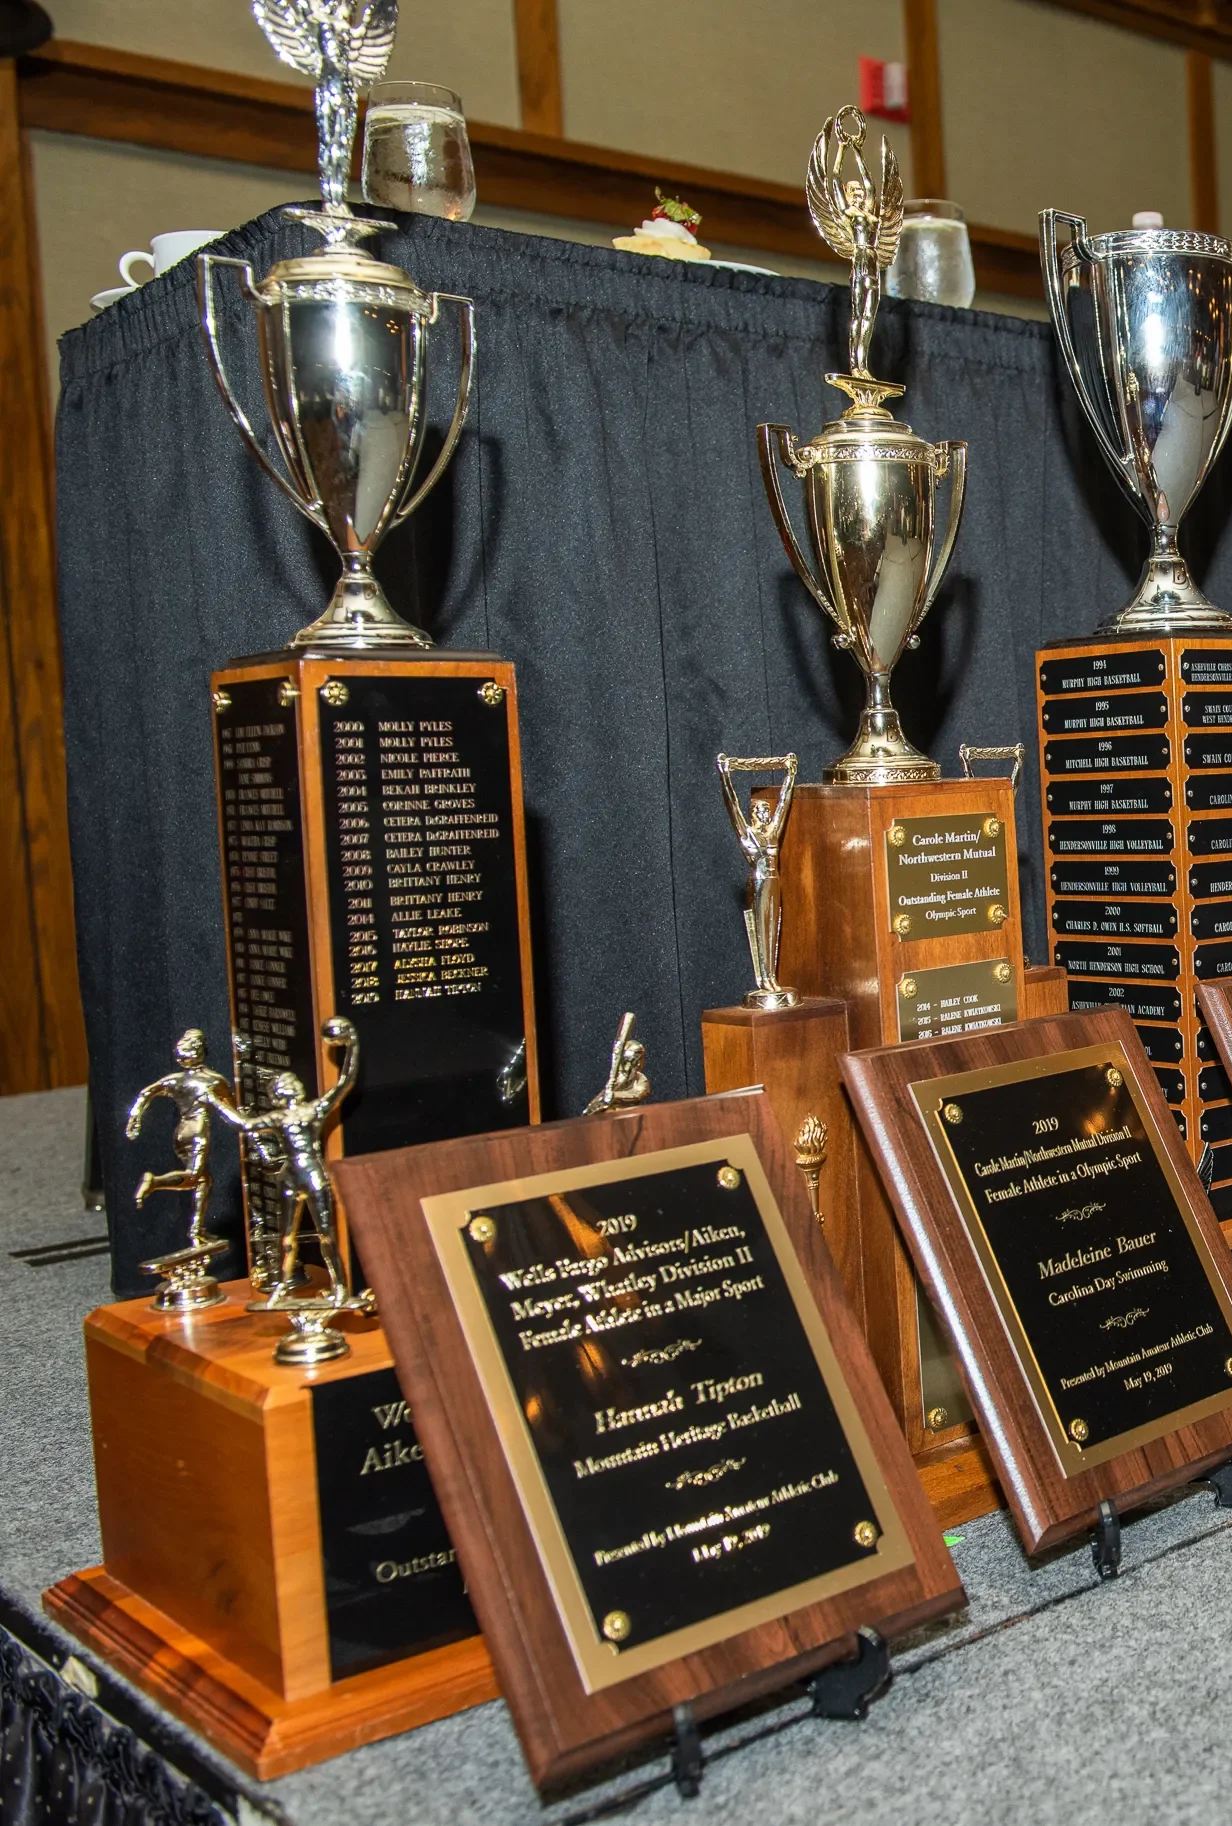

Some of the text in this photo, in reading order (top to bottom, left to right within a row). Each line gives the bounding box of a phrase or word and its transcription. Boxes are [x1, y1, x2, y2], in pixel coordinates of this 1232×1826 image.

[1093, 659, 1107, 670] 1994
[1061, 672, 1141, 689] MURPHY HIGH BASKETBALL
[1095, 700, 1110, 712] 1995
[335, 721, 452, 733] 2000 MOLLY PYLES
[1064, 714, 1145, 729] MURPHY HIGH BASKETBALL
[1098, 741, 1113, 752] 1996
[1065, 755, 1149, 769] MITCHELL HIGH BASKETBALL
[1202, 753, 1222, 764] SWAIN
[912, 829, 982, 846] Carole Martin/
[1059, 839, 1164, 850] HENDERSONVILLE HIGH VOLLEYBALL
[898, 845, 997, 866] Northwestern Mutual
[930, 869, 969, 883] Division II
[898, 886, 1001, 907] Outstanding Female Athlete
[925, 907, 977, 922] Olympic Sport
[1032, 1116, 1059, 1135] 2019
[974, 1125, 1133, 1177] Carole Martin/Northwestern Mutual Division II
[984, 1182, 1023, 1204] Female
[1023, 1174, 1059, 1194] Athlete
[1056, 1169, 1070, 1184] in
[1076, 1156, 1118, 1179] Olympic
[1115, 1151, 1142, 1170] Sport
[596, 1214, 637, 1241] 2019
[498, 1225, 746, 1291] Wells Fargo Advisors/Aiken,
[1037, 1232, 1157, 1280] Madeleine Bauer
[510, 1245, 754, 1321] Meyer, Whatley Division II
[1048, 1260, 1169, 1306] Carolina Day Swimming
[518, 1318, 582, 1351] Female
[585, 1306, 642, 1335] Athlete
[641, 1300, 663, 1319] in
[673, 1286, 721, 1310] Major
[721, 1275, 765, 1300] Sport
[1060, 1323, 1214, 1390] Presented by Mountain Amateur Athletic Club
[1123, 1362, 1173, 1391] May 19, 2019
[594, 1372, 763, 1434] Hannah Tipton
[573, 1392, 802, 1479] Mountain Heritage Basketball
